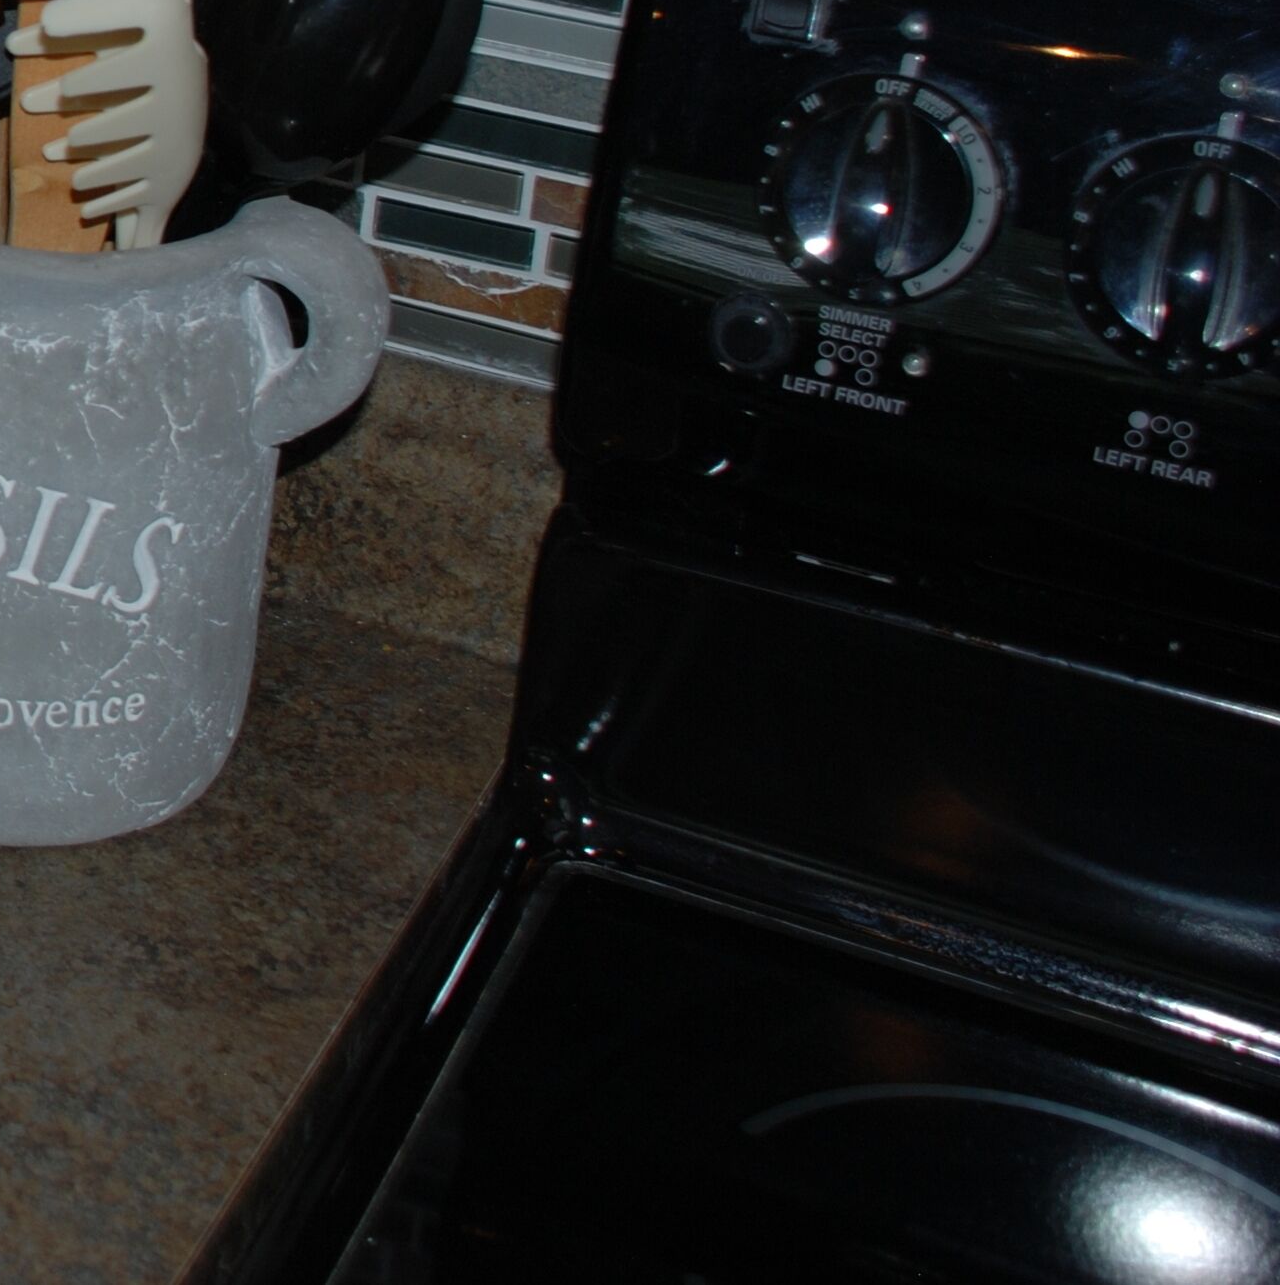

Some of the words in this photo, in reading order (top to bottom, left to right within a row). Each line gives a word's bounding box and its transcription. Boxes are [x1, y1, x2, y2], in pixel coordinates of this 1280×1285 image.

[874, 79, 912, 96] OFF
[799, 93, 823, 114] HI
[1192, 140, 1233, 159] OFF
[1111, 157, 1135, 178] HI
[818, 305, 893, 333] SIMMER
[818, 323, 887, 348] SELECT
[781, 373, 833, 399] LEFT
[834, 386, 908, 416] FRONT
[1092, 445, 1147, 471] LEFT
[1150, 459, 1215, 489] REAR
